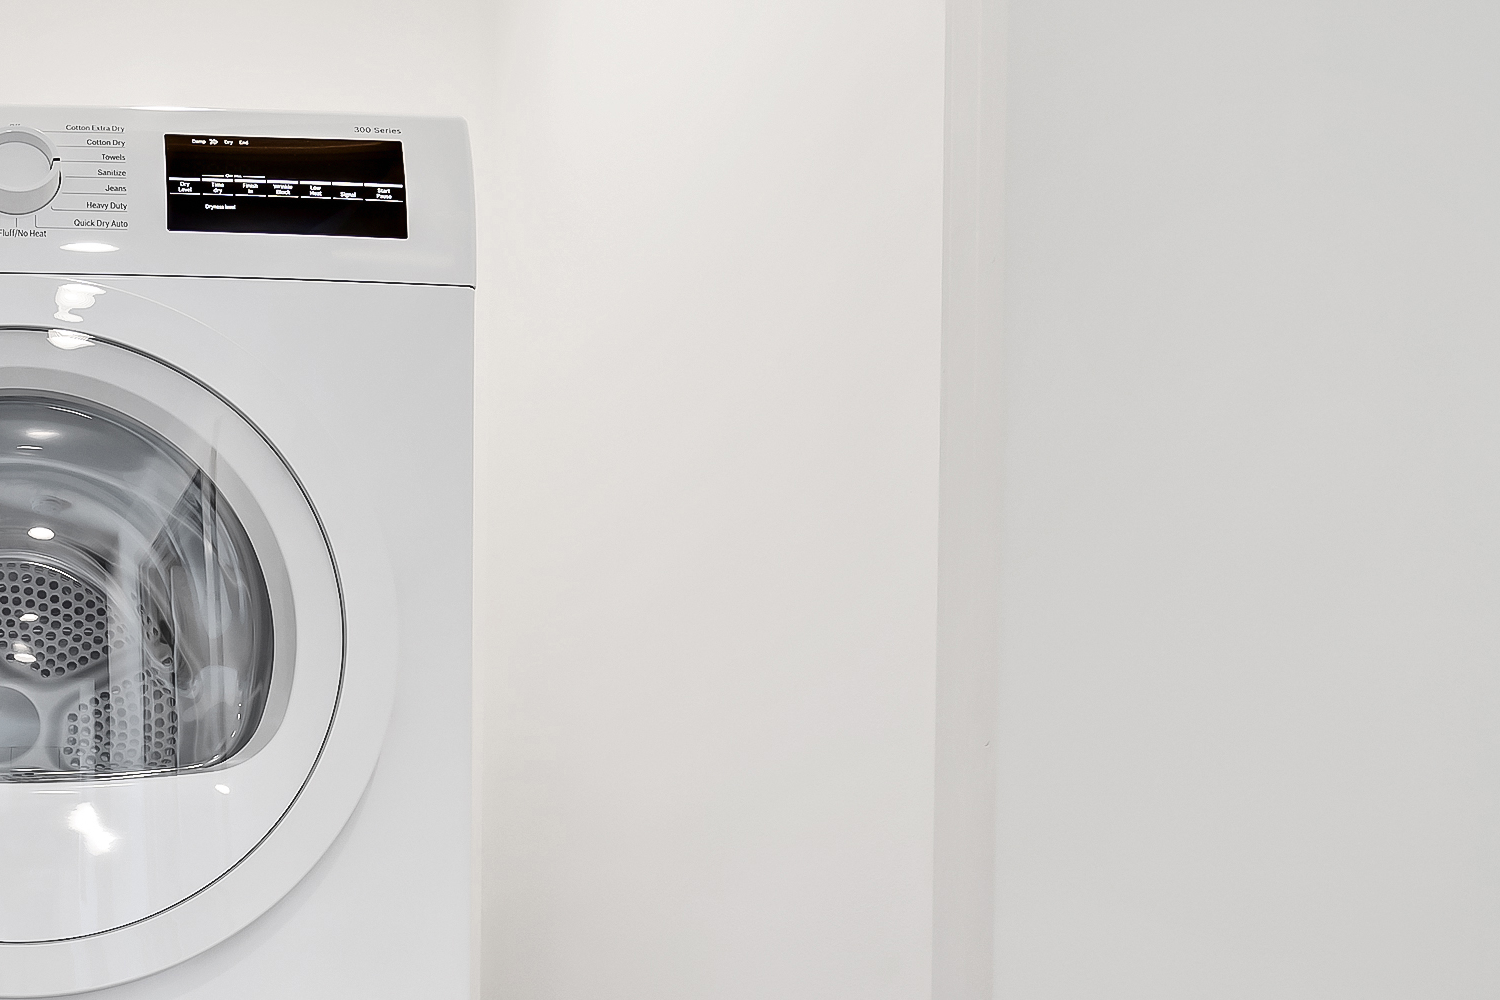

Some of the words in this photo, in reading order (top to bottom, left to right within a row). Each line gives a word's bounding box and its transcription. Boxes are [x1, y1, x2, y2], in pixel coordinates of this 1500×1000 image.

[101, 153, 126, 161] Towels
[97, 168, 127, 177] Sanitize
[104, 184, 127, 192] Jeans
[86, 201, 109, 211] Heavy
[110, 202, 128, 211] Duty
[73, 218, 95, 227] Quick
[96, 219, 110, 229] Dry
[110, 219, 129, 228] Auto
[29, 230, 47, 238] Heat
